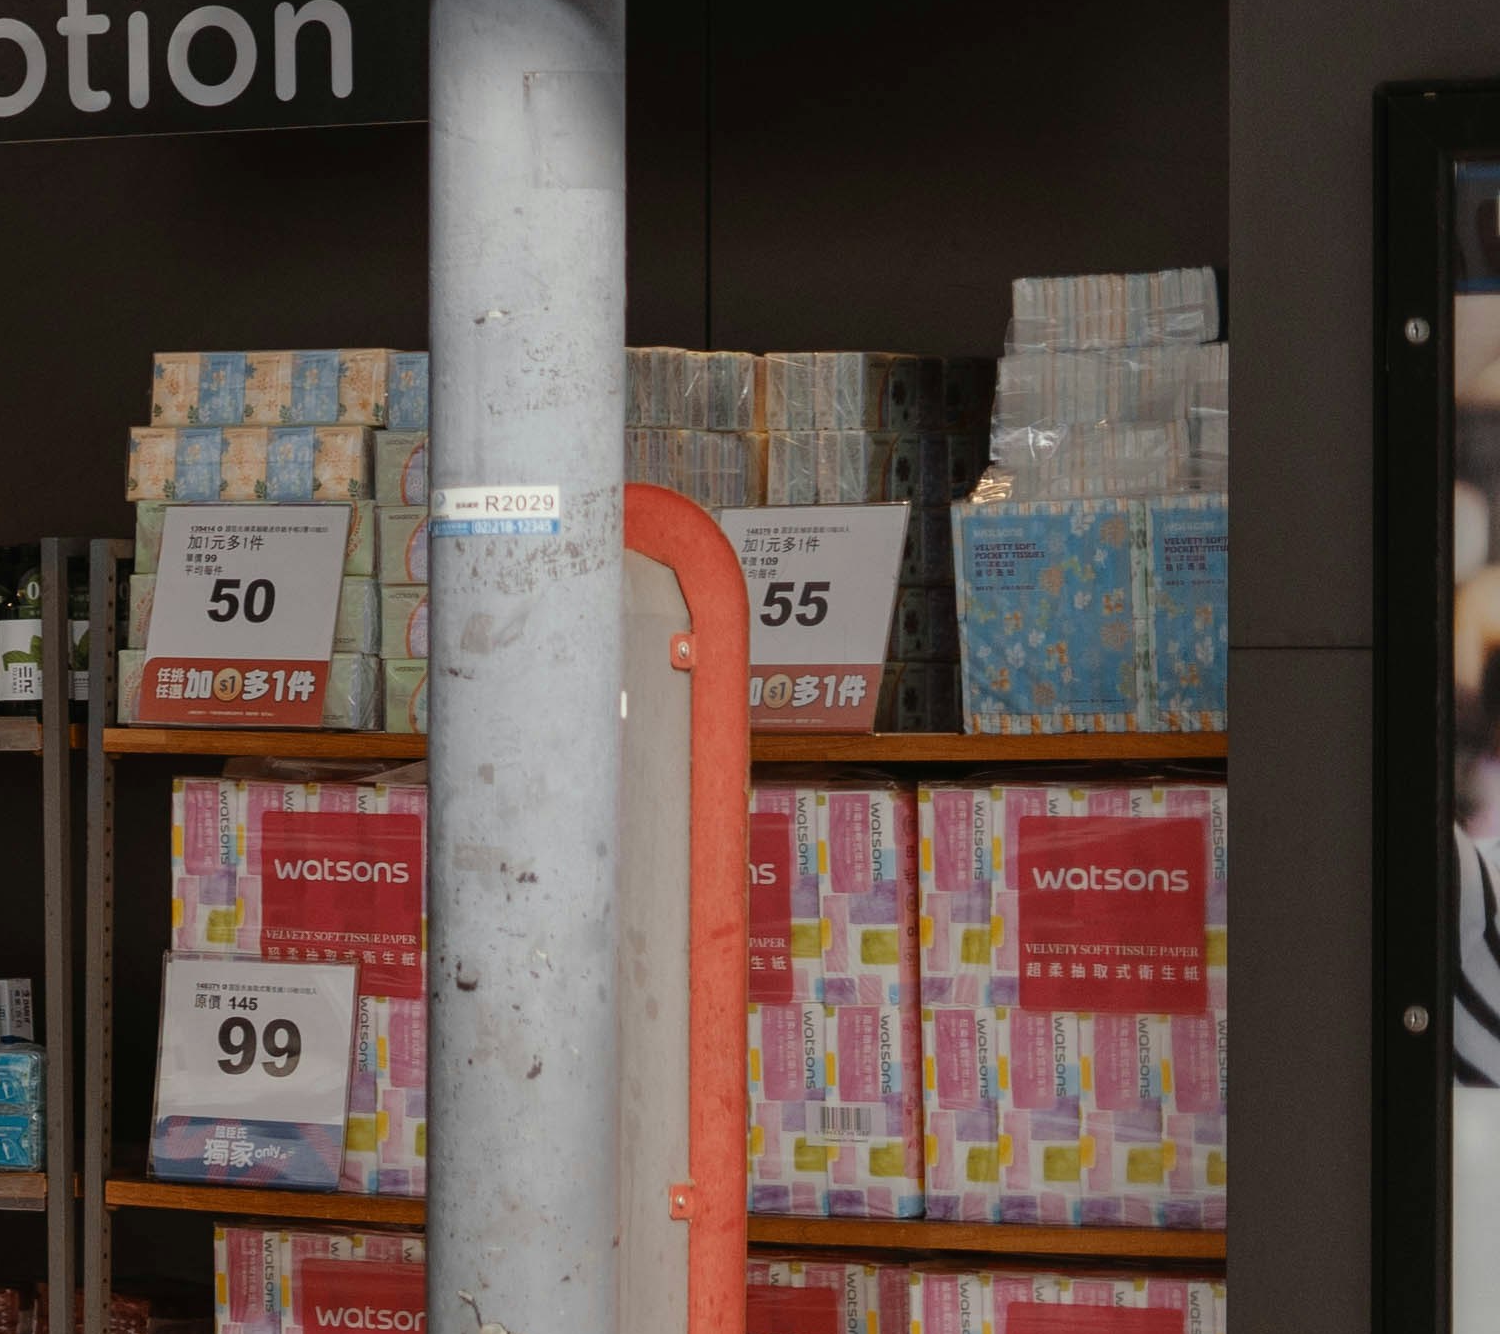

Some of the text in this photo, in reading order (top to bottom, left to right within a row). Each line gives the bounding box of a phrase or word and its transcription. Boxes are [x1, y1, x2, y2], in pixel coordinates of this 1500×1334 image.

[485, 494, 554, 513] R2029
[187, 534, 264, 551] 加1元多1件
[741, 535, 820, 553] 加1元多1件
[204, 553, 217, 563] 99
[760, 556, 778, 566] 109
[207, 577, 275, 624] 50
[760, 582, 830, 628] 55
[273, 858, 410, 884] watsons
[1032, 867, 1189, 892] watsons
[266, 929, 416, 946] VELVETY SOFT TISSUE PAPER
[749, 938, 786, 949] PAPER
[1025, 942, 1198, 959] VELVETY SOFT TISSUE PAPER
[1025, 962, 1200, 982] 超柔抽取式衛生紙
[194, 993, 258, 1011] 原價 145
[217, 1017, 302, 1077] 99
[203, 1138, 281, 1168] 獨家 only
